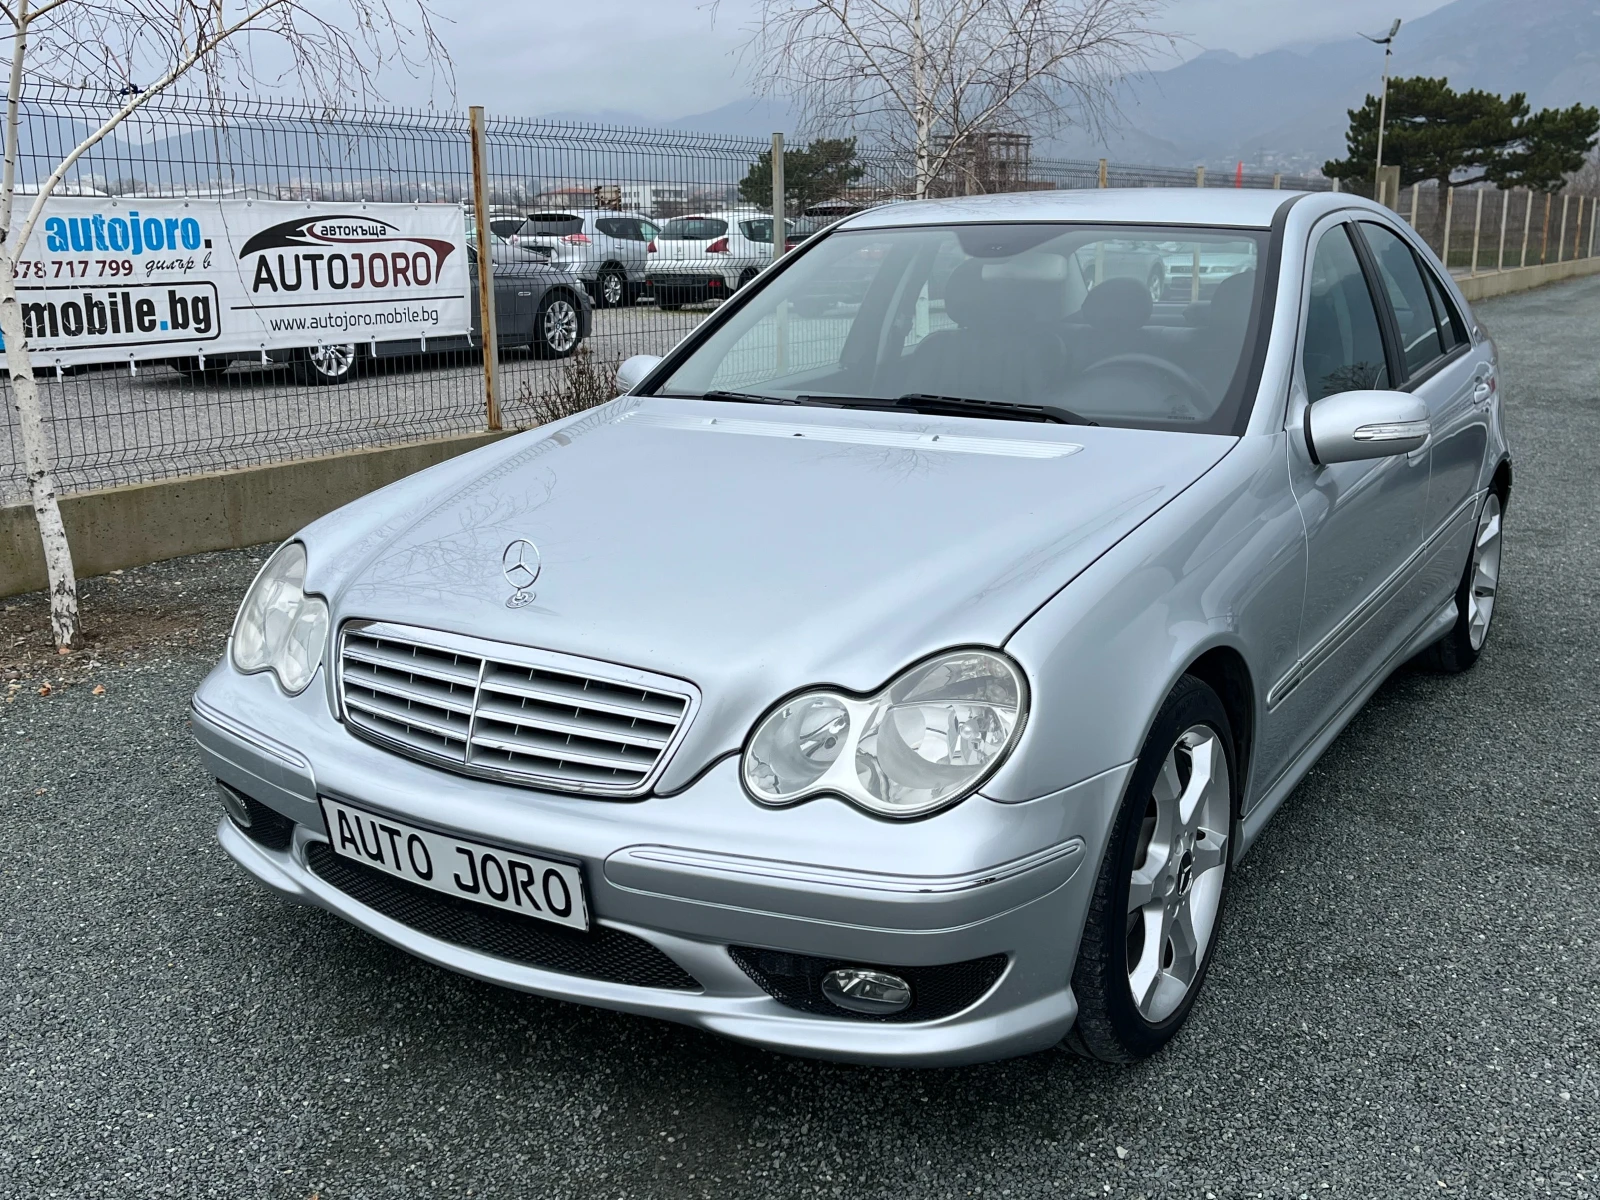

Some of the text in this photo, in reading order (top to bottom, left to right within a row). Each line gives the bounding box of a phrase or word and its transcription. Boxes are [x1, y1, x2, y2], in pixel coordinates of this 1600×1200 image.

[320, 224, 387, 238] автокъща
[51, 260, 89, 278] 717
[95, 259, 133, 277] 799
[145, 256, 196, 277] дилър
[252, 251, 432, 293] AUTOJORO
[21, 290, 212, 338] mobile.bg
[269, 306, 439, 332] www.autojoro.mobile.bg
[337, 808, 572, 918] AUTO JORO
